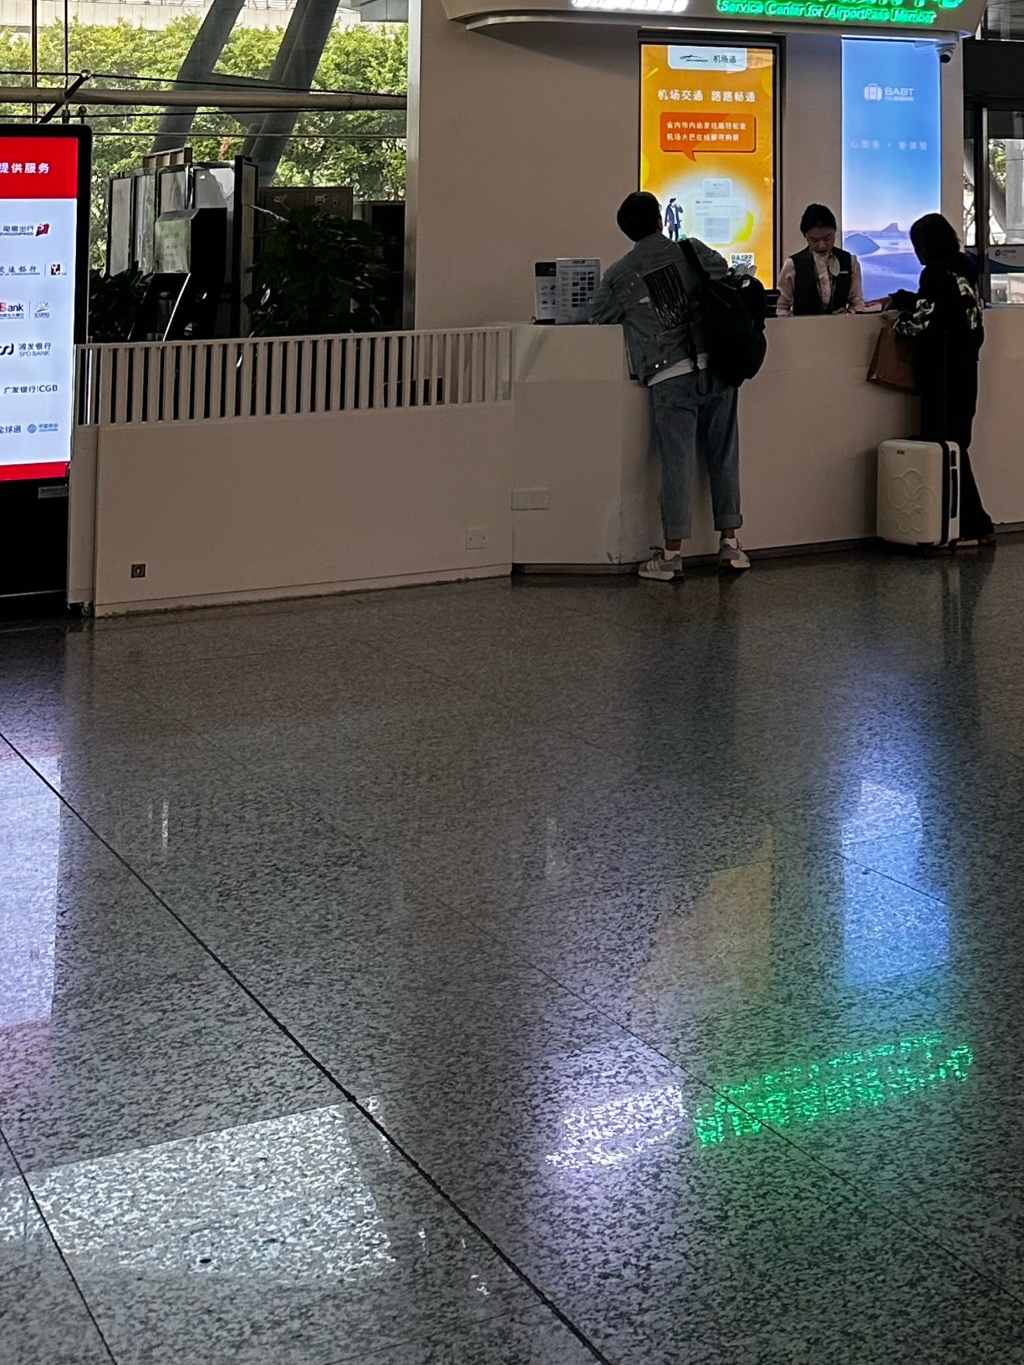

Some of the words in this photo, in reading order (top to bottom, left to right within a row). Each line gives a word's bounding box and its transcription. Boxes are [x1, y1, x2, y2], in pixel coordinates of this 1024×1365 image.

[766, 0, 806, 16] Center
[806, 3, 824, 17] for
[891, 7, 937, 23] Member
[713, 55, 737, 63] 机场通
[657, 90, 703, 101] 机场交通
[711, 91, 755, 102] 路路畅通
[884, 87, 914, 97] BABT
